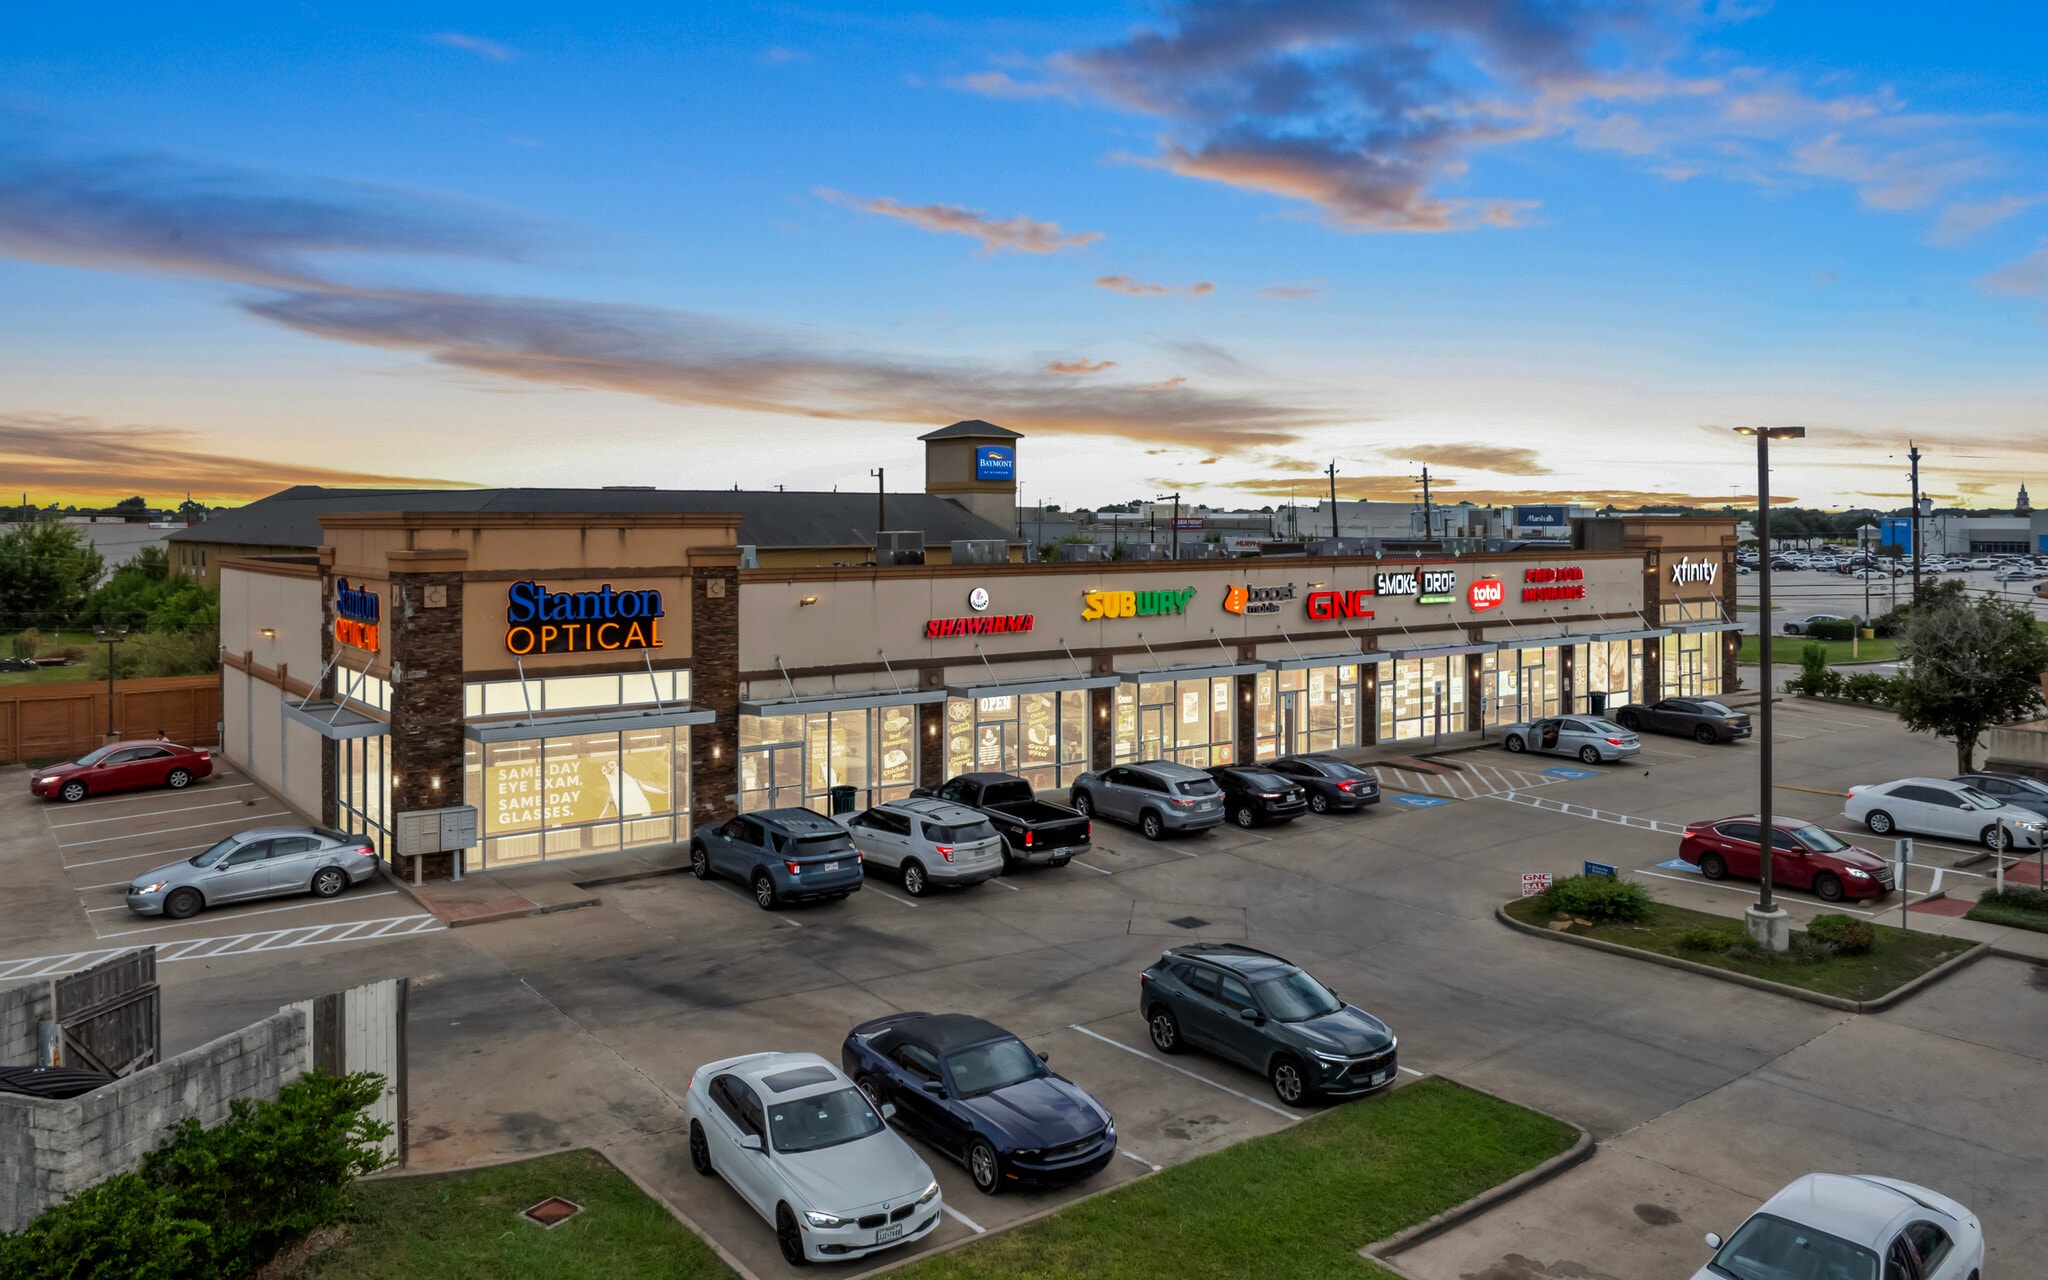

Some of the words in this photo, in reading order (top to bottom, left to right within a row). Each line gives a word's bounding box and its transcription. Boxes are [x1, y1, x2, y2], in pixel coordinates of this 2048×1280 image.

[980, 459, 1013, 467] BAYMONT
[1672, 556, 1718, 586] xfinity
[1246, 582, 1298, 602] boost
[1377, 573, 1417, 595] SMOKE
[1423, 571, 1457, 593] DROP
[1473, 582, 1501, 601] total
[336, 577, 379, 620] Stanton
[509, 580, 666, 623] Stanton
[1081, 586, 1197, 621] SUBWAY
[1522, 585, 1586, 602] INSURANCE
[1246, 603, 1280, 614] mobile
[1307, 589, 1376, 621] GNC
[335, 617, 379, 652] OPTICAL
[925, 614, 1035, 637] SHAWARMA
[507, 620, 665, 655] OPTICAL
[981, 695, 1012, 711] OPEN
[1028, 743, 1049, 751] Gyro
[498, 761, 580, 781] SAME-DAY
[883, 765, 909, 776] Chicken
[498, 782, 527, 794] EYE
[534, 775, 583, 791] EXAM.
[498, 790, 581, 811] SAME-DAY
[498, 805, 574, 825] GLASSES.
[1523, 873, 1551, 881] GNC
